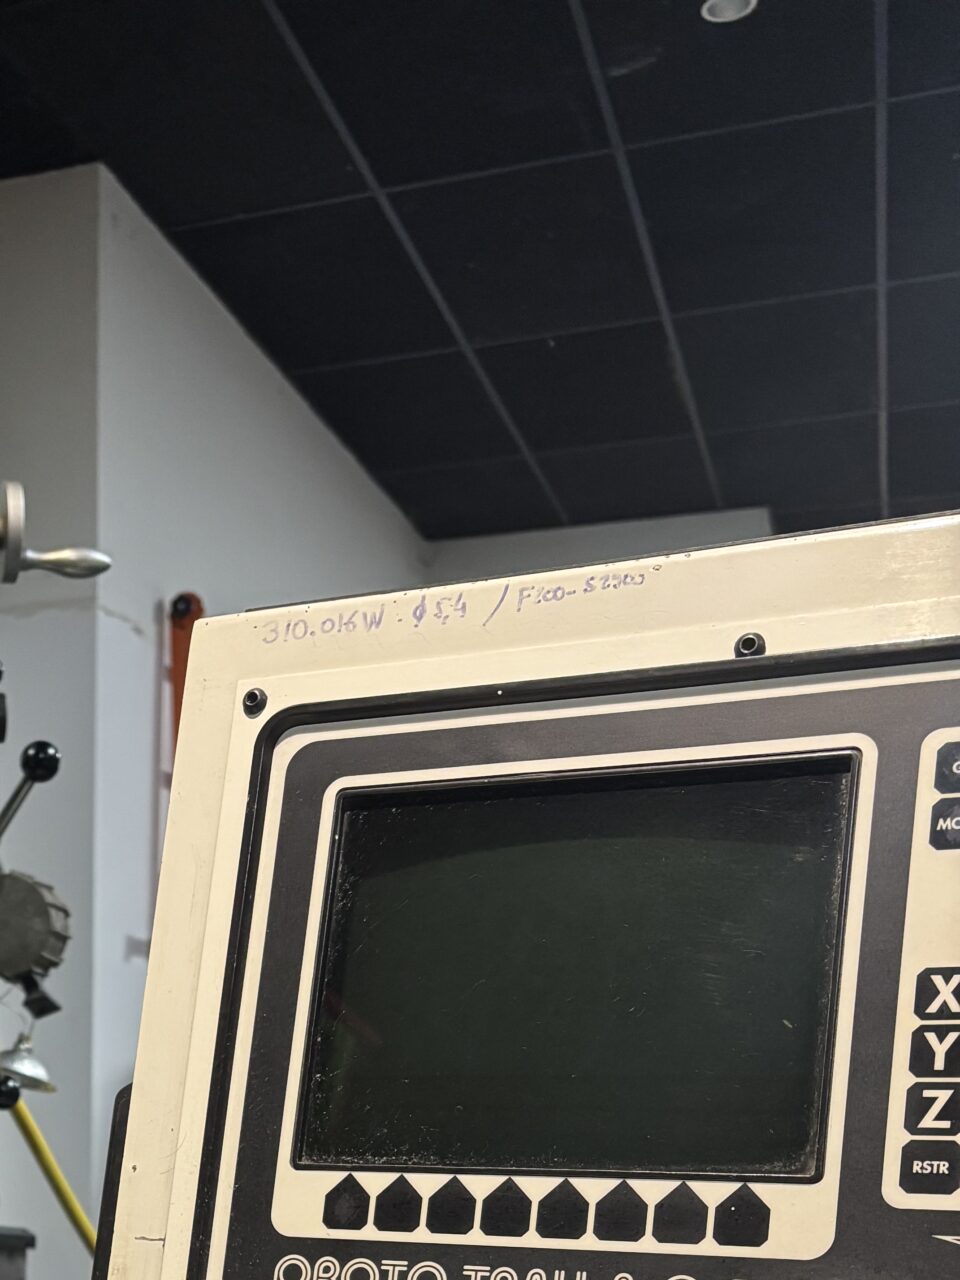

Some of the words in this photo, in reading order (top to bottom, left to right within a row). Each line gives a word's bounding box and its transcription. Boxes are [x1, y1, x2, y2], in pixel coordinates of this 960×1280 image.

[924, 974, 960, 1013] X
[923, 1032, 960, 1071] Y
[917, 1089, 955, 1129] Z
[912, 1160, 950, 1175] RSTR
